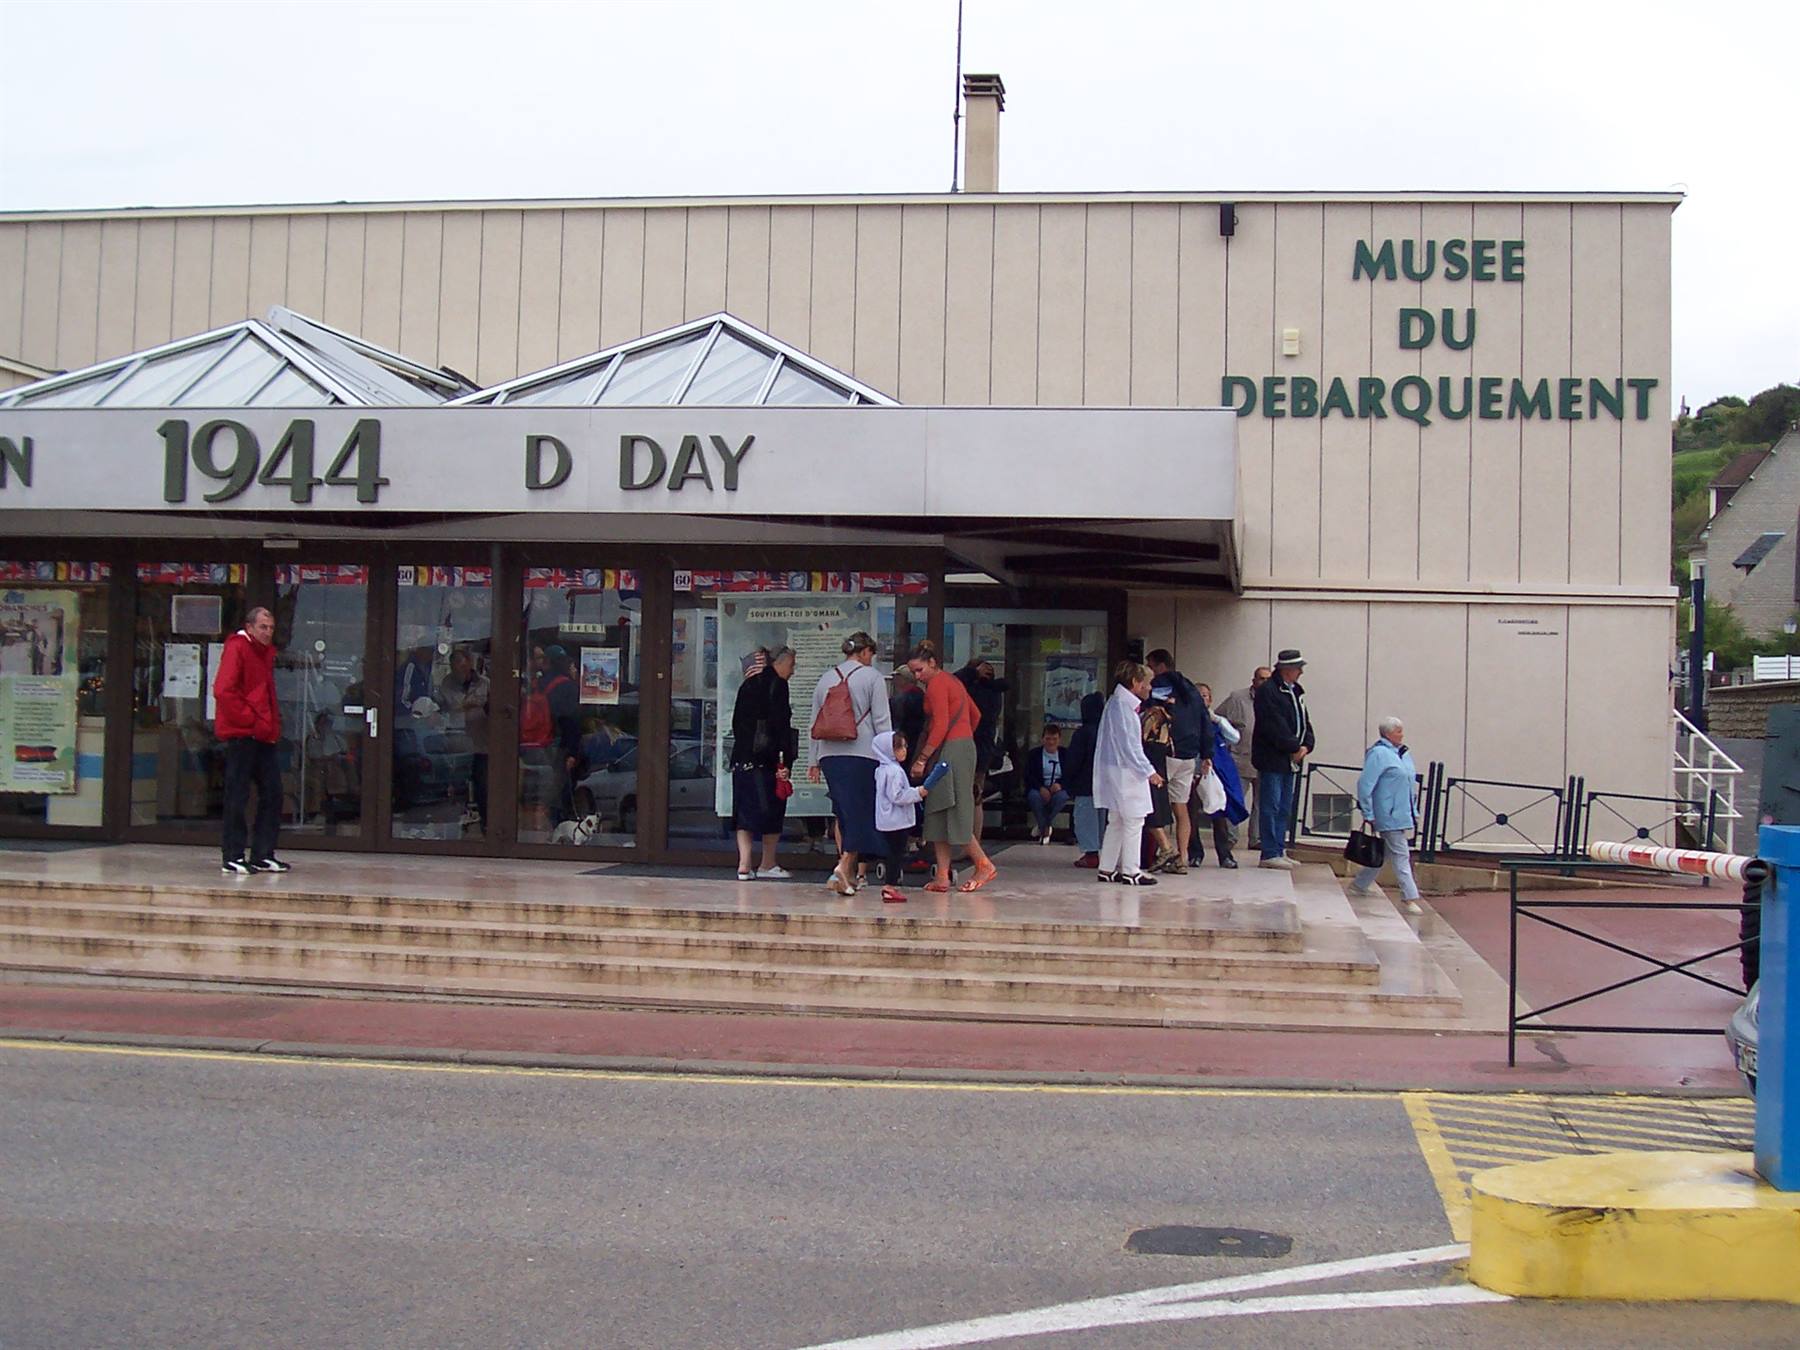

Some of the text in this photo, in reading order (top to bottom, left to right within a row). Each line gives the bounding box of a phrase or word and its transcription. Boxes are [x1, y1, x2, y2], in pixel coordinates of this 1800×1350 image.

[1353, 239, 1525, 282] MUSEE
[1398, 308, 1477, 350] DU
[1222, 376, 1659, 427] DEBARQUEMENT
[156, 419, 391, 503] 1944
[526, 435, 573, 490] D
[620, 435, 756, 492] DAY
[675, 575, 690, 585] 60
